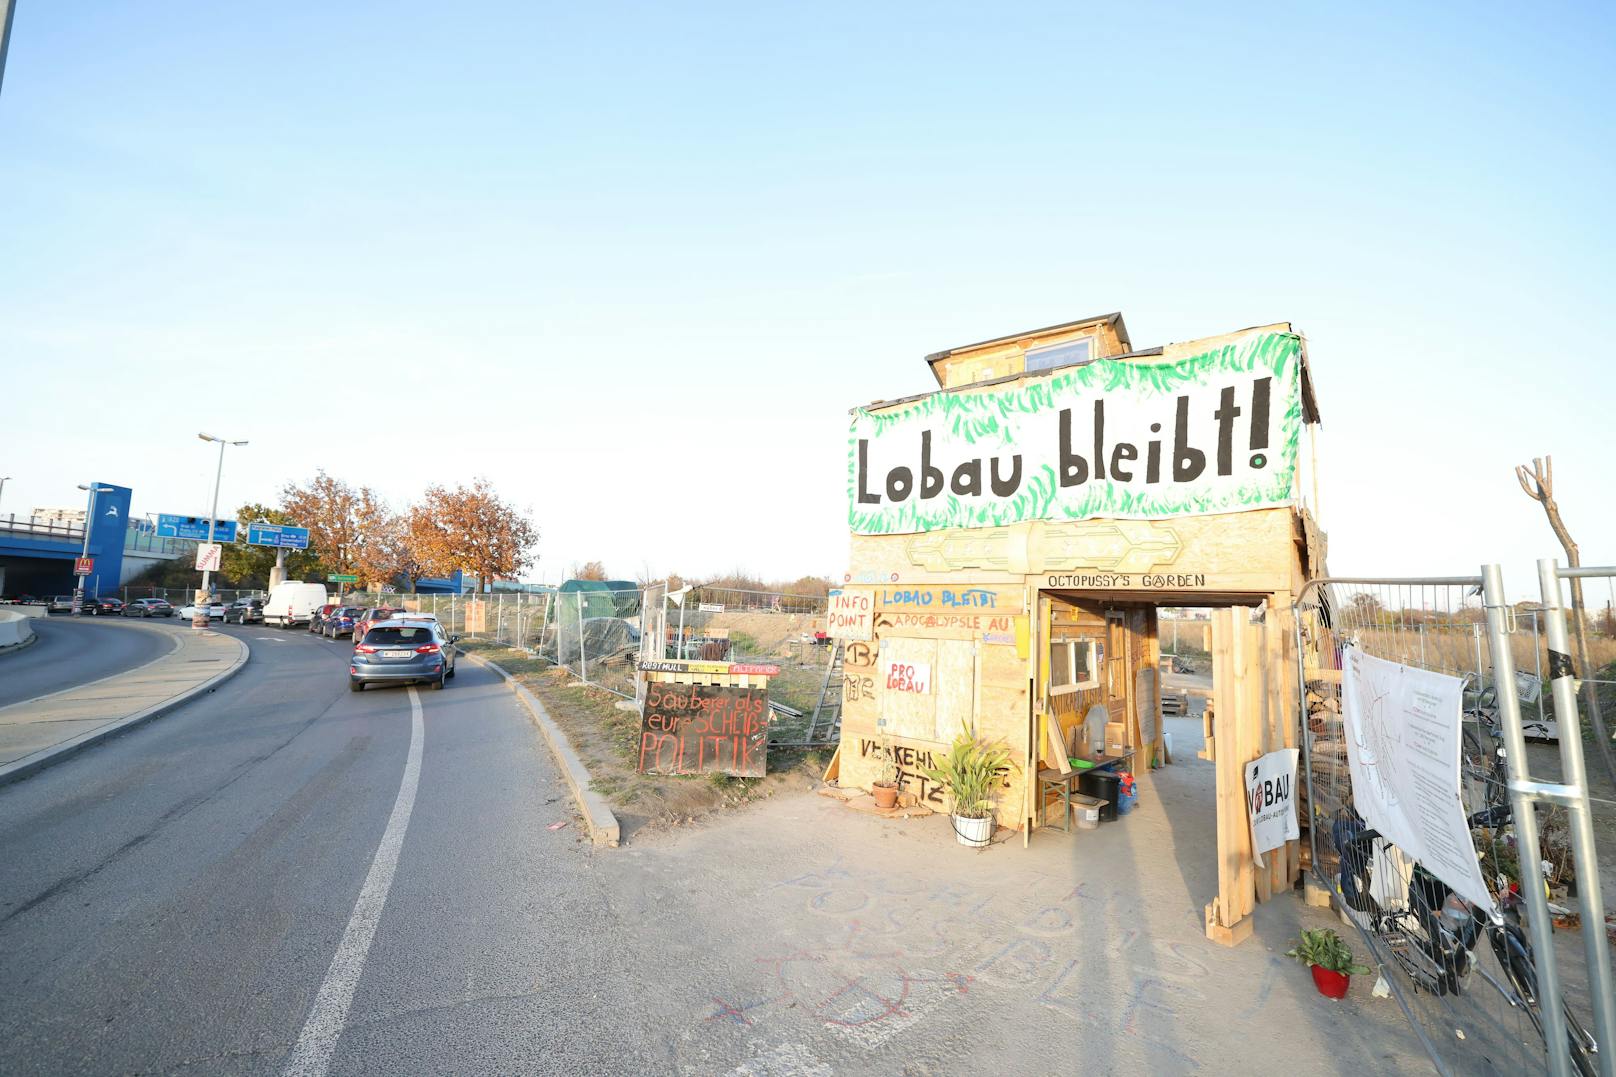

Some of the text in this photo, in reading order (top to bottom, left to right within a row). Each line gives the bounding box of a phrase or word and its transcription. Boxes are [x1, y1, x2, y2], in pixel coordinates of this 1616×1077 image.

[858, 377, 1272, 503] Lobau bleibt!
[1048, 574, 1205, 588] OCTOPUSSY'S GARDEN
[835, 596, 868, 610] INFO
[883, 589, 997, 609] LOBAU BLEIBT
[829, 613, 866, 627] POINT
[891, 663, 915, 680] PRO
[640, 732, 766, 774] POLITIK
